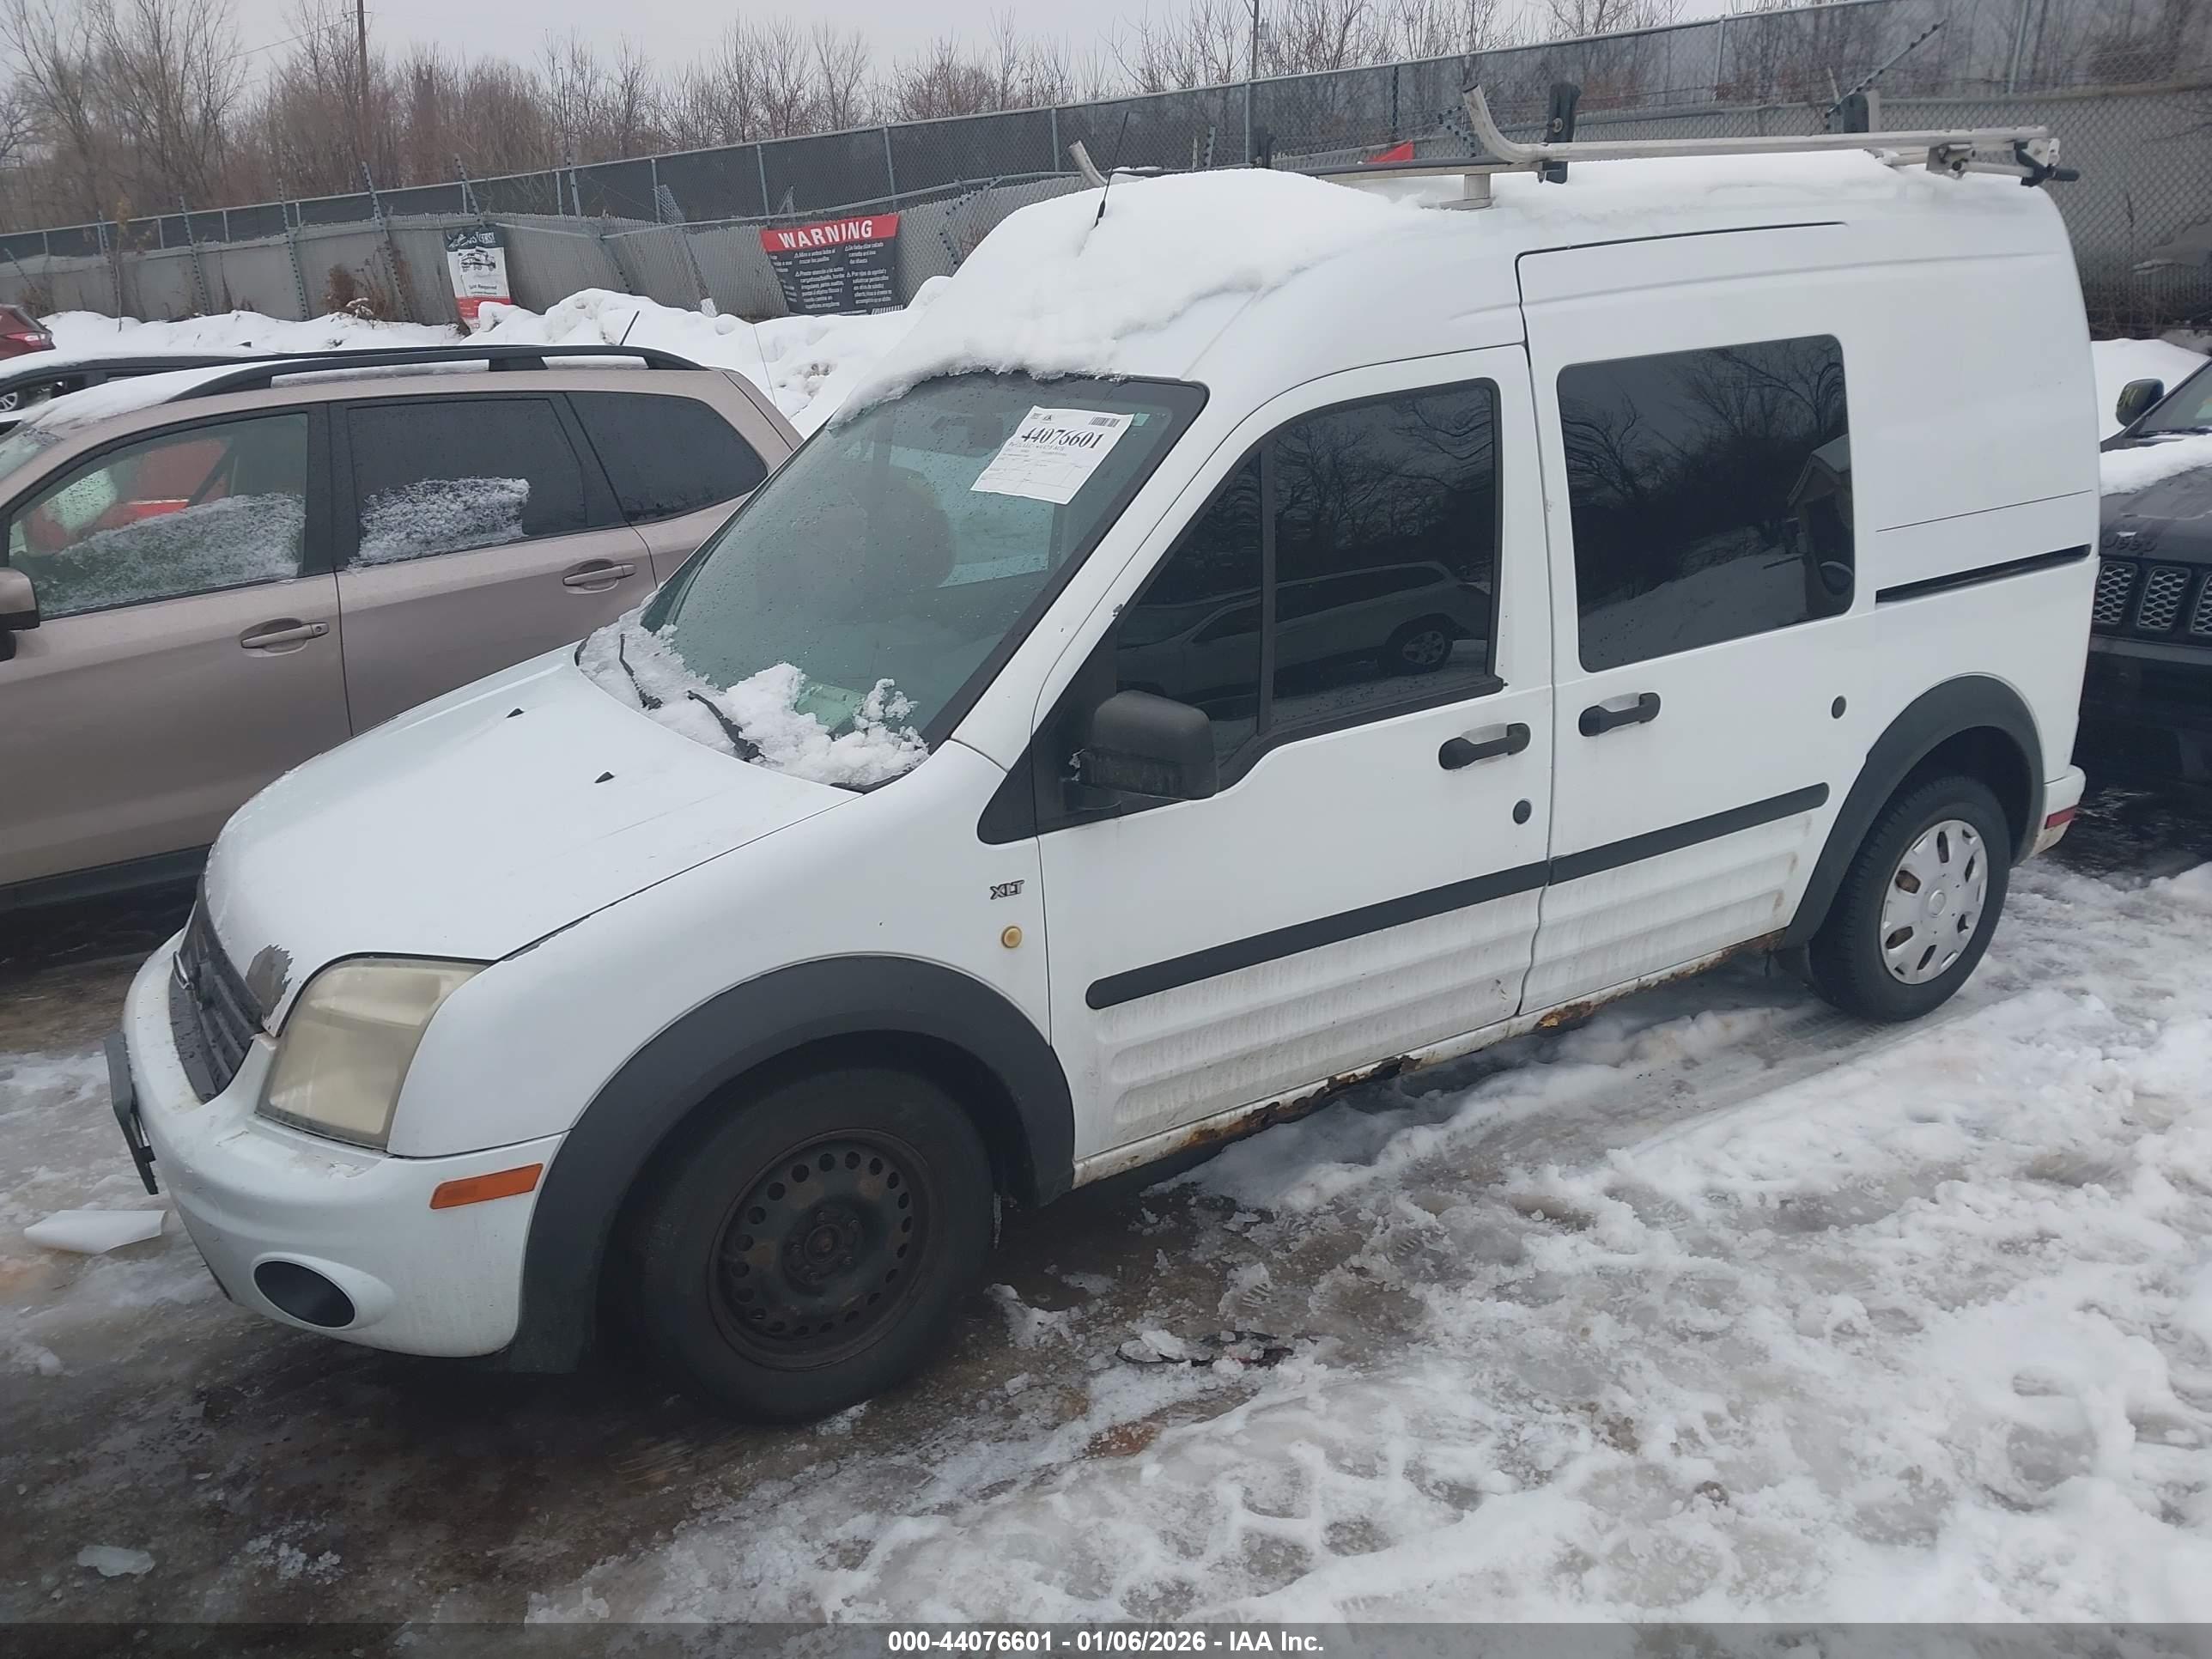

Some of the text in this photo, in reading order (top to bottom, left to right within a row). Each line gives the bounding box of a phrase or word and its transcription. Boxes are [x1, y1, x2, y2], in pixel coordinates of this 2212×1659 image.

[778, 220, 873, 248] WARNING
[1022, 428, 1105, 449] 44076601
[990, 879, 1024, 900] XLT
